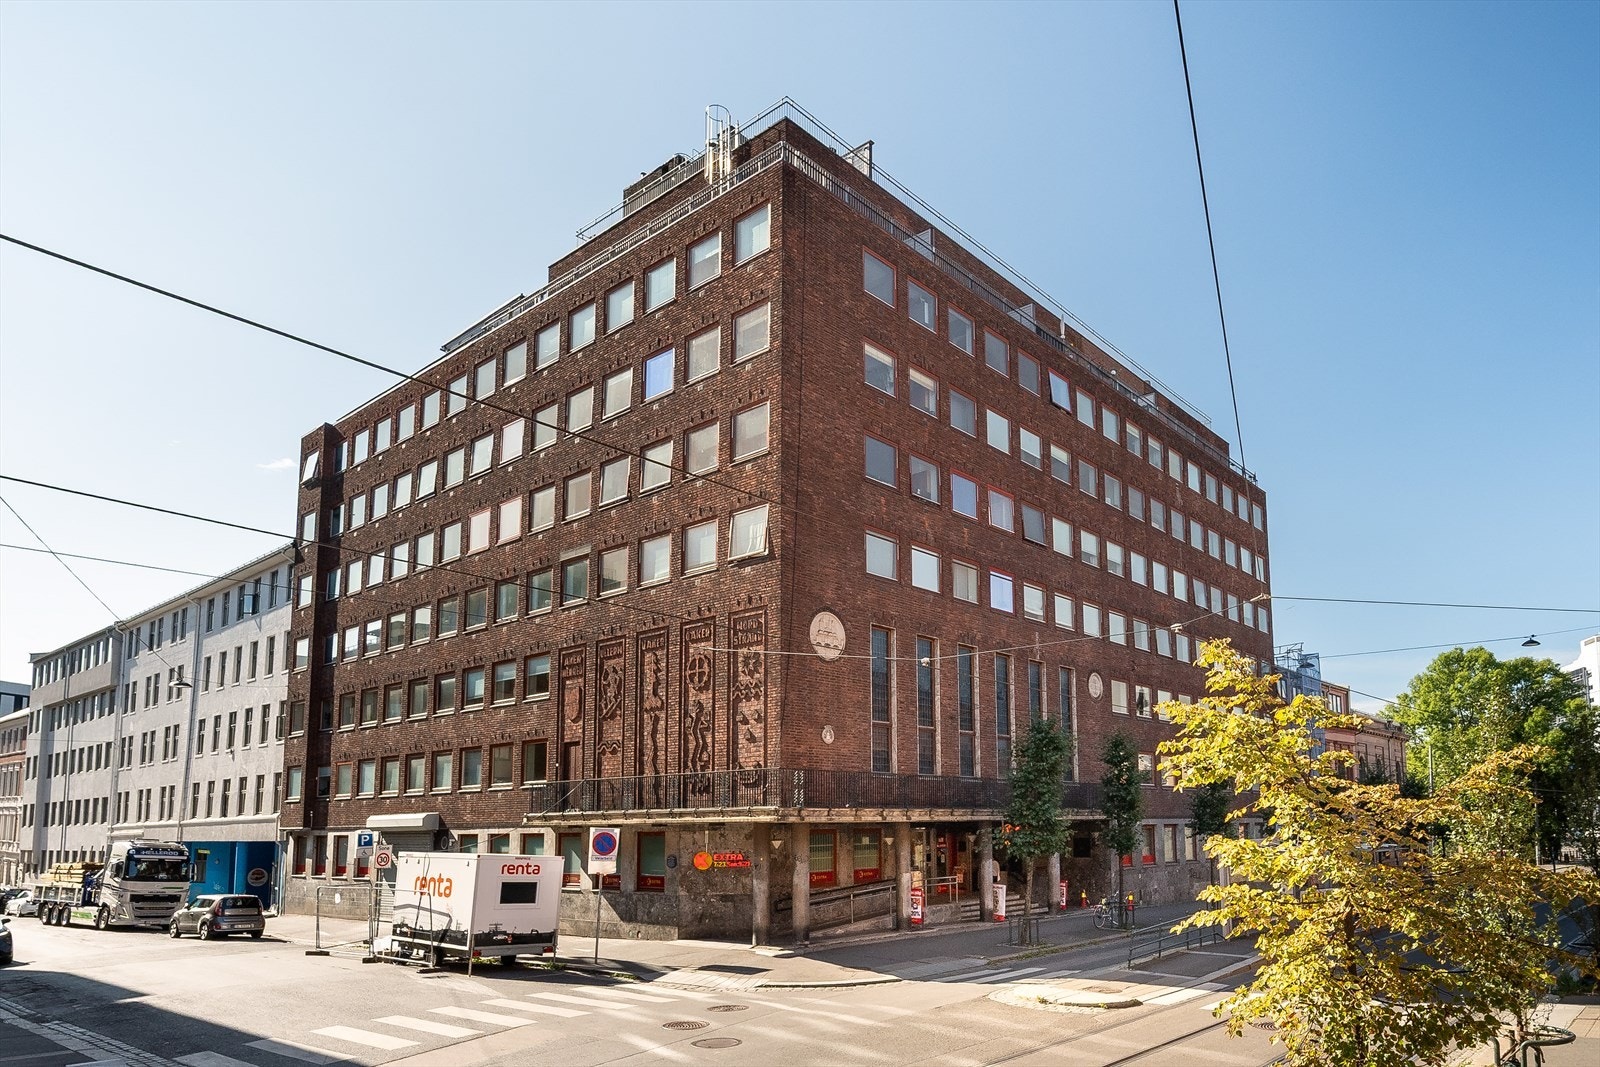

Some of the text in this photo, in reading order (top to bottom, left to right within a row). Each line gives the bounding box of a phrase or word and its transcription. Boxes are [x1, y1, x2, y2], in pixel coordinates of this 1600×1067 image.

[361, 835, 370, 845] P
[713, 853, 744, 861] EXTRA
[501, 862, 541, 875] renta
[414, 873, 453, 898] renta
